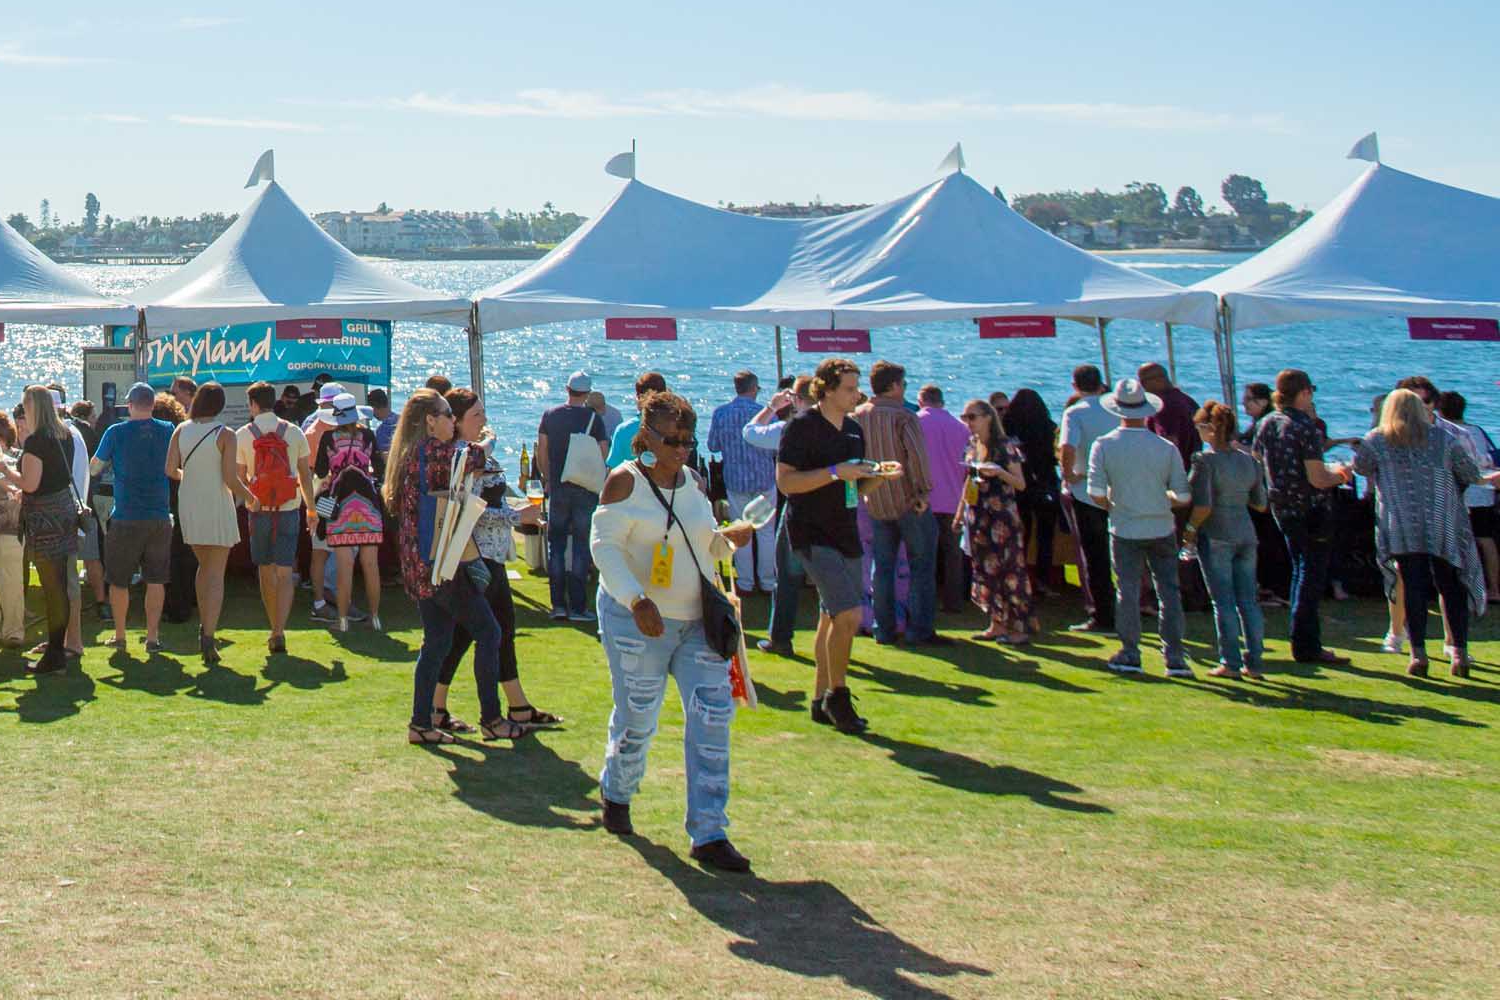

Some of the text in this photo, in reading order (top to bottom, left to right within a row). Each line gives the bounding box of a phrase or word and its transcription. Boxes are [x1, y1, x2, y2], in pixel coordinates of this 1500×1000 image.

[346, 323, 381, 333] GRILL
[310, 335, 371, 347] CATERING
[287, 362, 381, 374] GOPORKYLAND.COM
